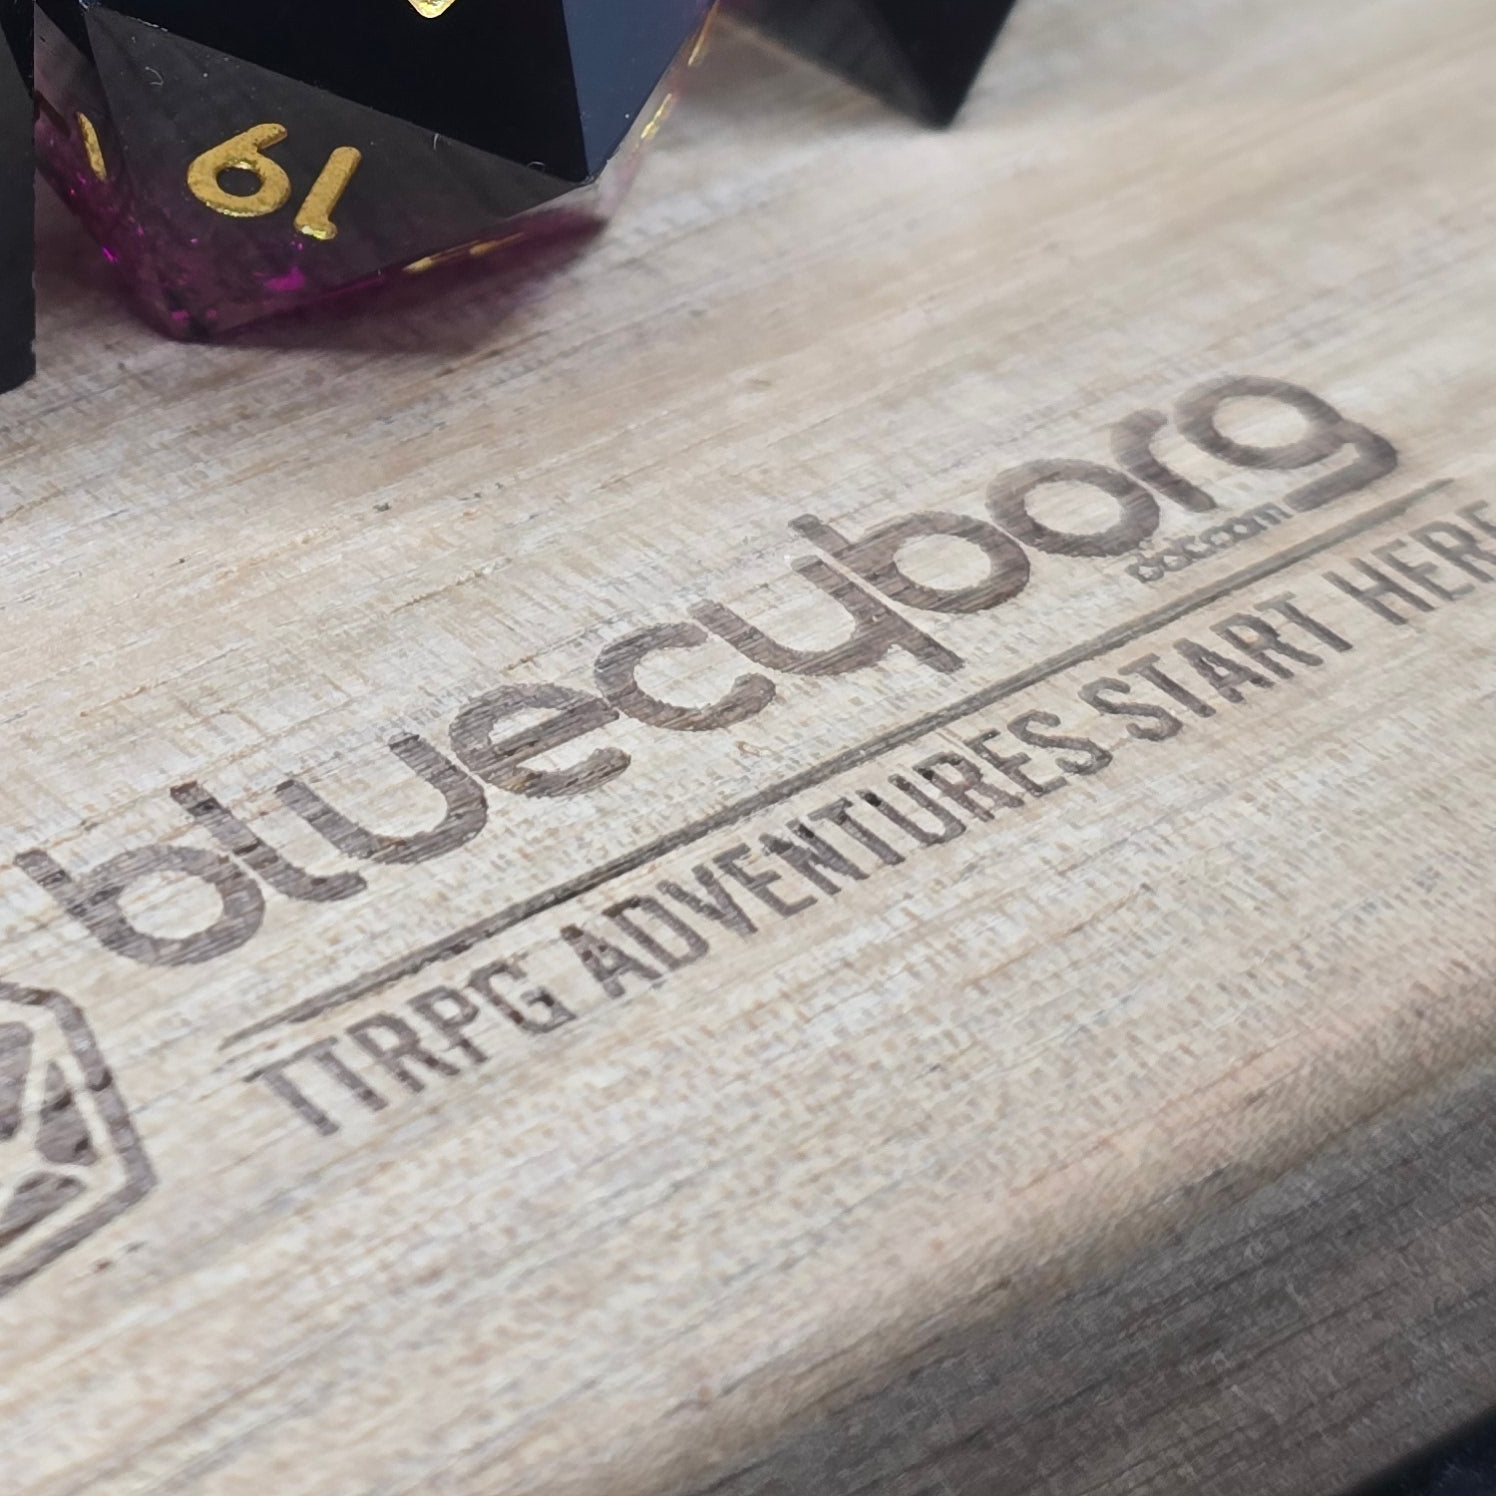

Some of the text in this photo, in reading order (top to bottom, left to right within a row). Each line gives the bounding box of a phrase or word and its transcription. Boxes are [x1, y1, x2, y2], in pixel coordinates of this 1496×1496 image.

[12, 374, 1400, 970] bluecyborg
[242, 951, 578, 1138] TTRPG
[559, 707, 1116, 1002] ADVENTURES
[1077, 592, 1355, 746] START
